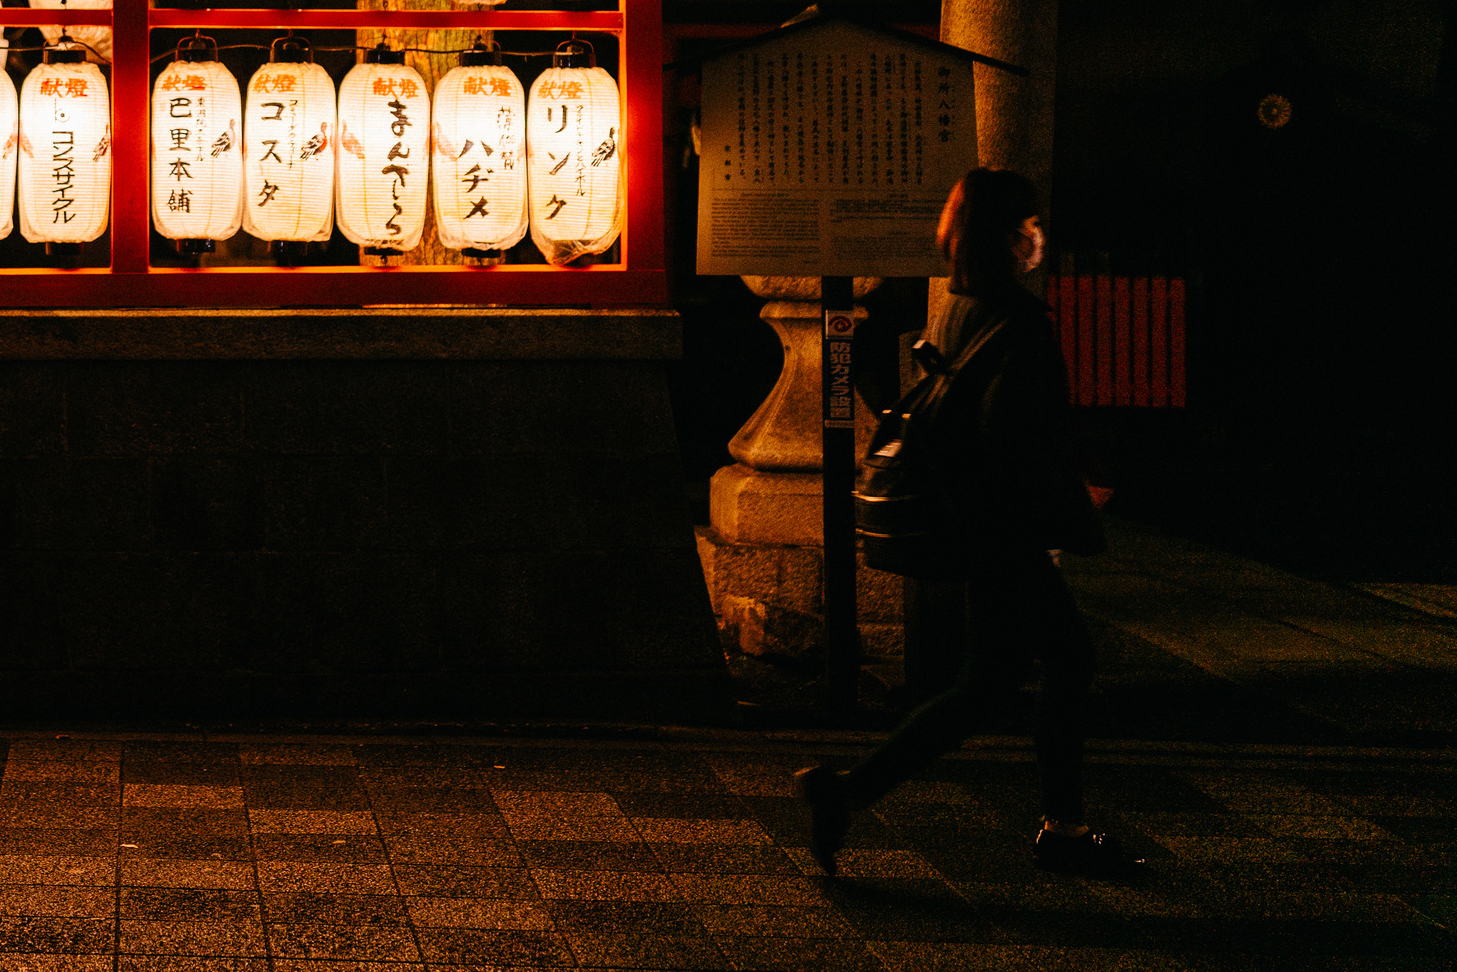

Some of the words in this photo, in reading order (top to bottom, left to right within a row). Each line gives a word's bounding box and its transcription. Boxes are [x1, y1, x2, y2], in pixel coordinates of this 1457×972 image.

[40, 77, 90, 98] 献燈
[161, 75, 209, 92] 献燈
[253, 74, 298, 94] 献燈
[372, 77, 420, 99] 献燈
[463, 76, 512, 97] 献燈
[167, 97, 194, 215] 巴里本舗
[257, 101, 286, 208] コスタ
[52, 130, 78, 224] コンズサイクル
